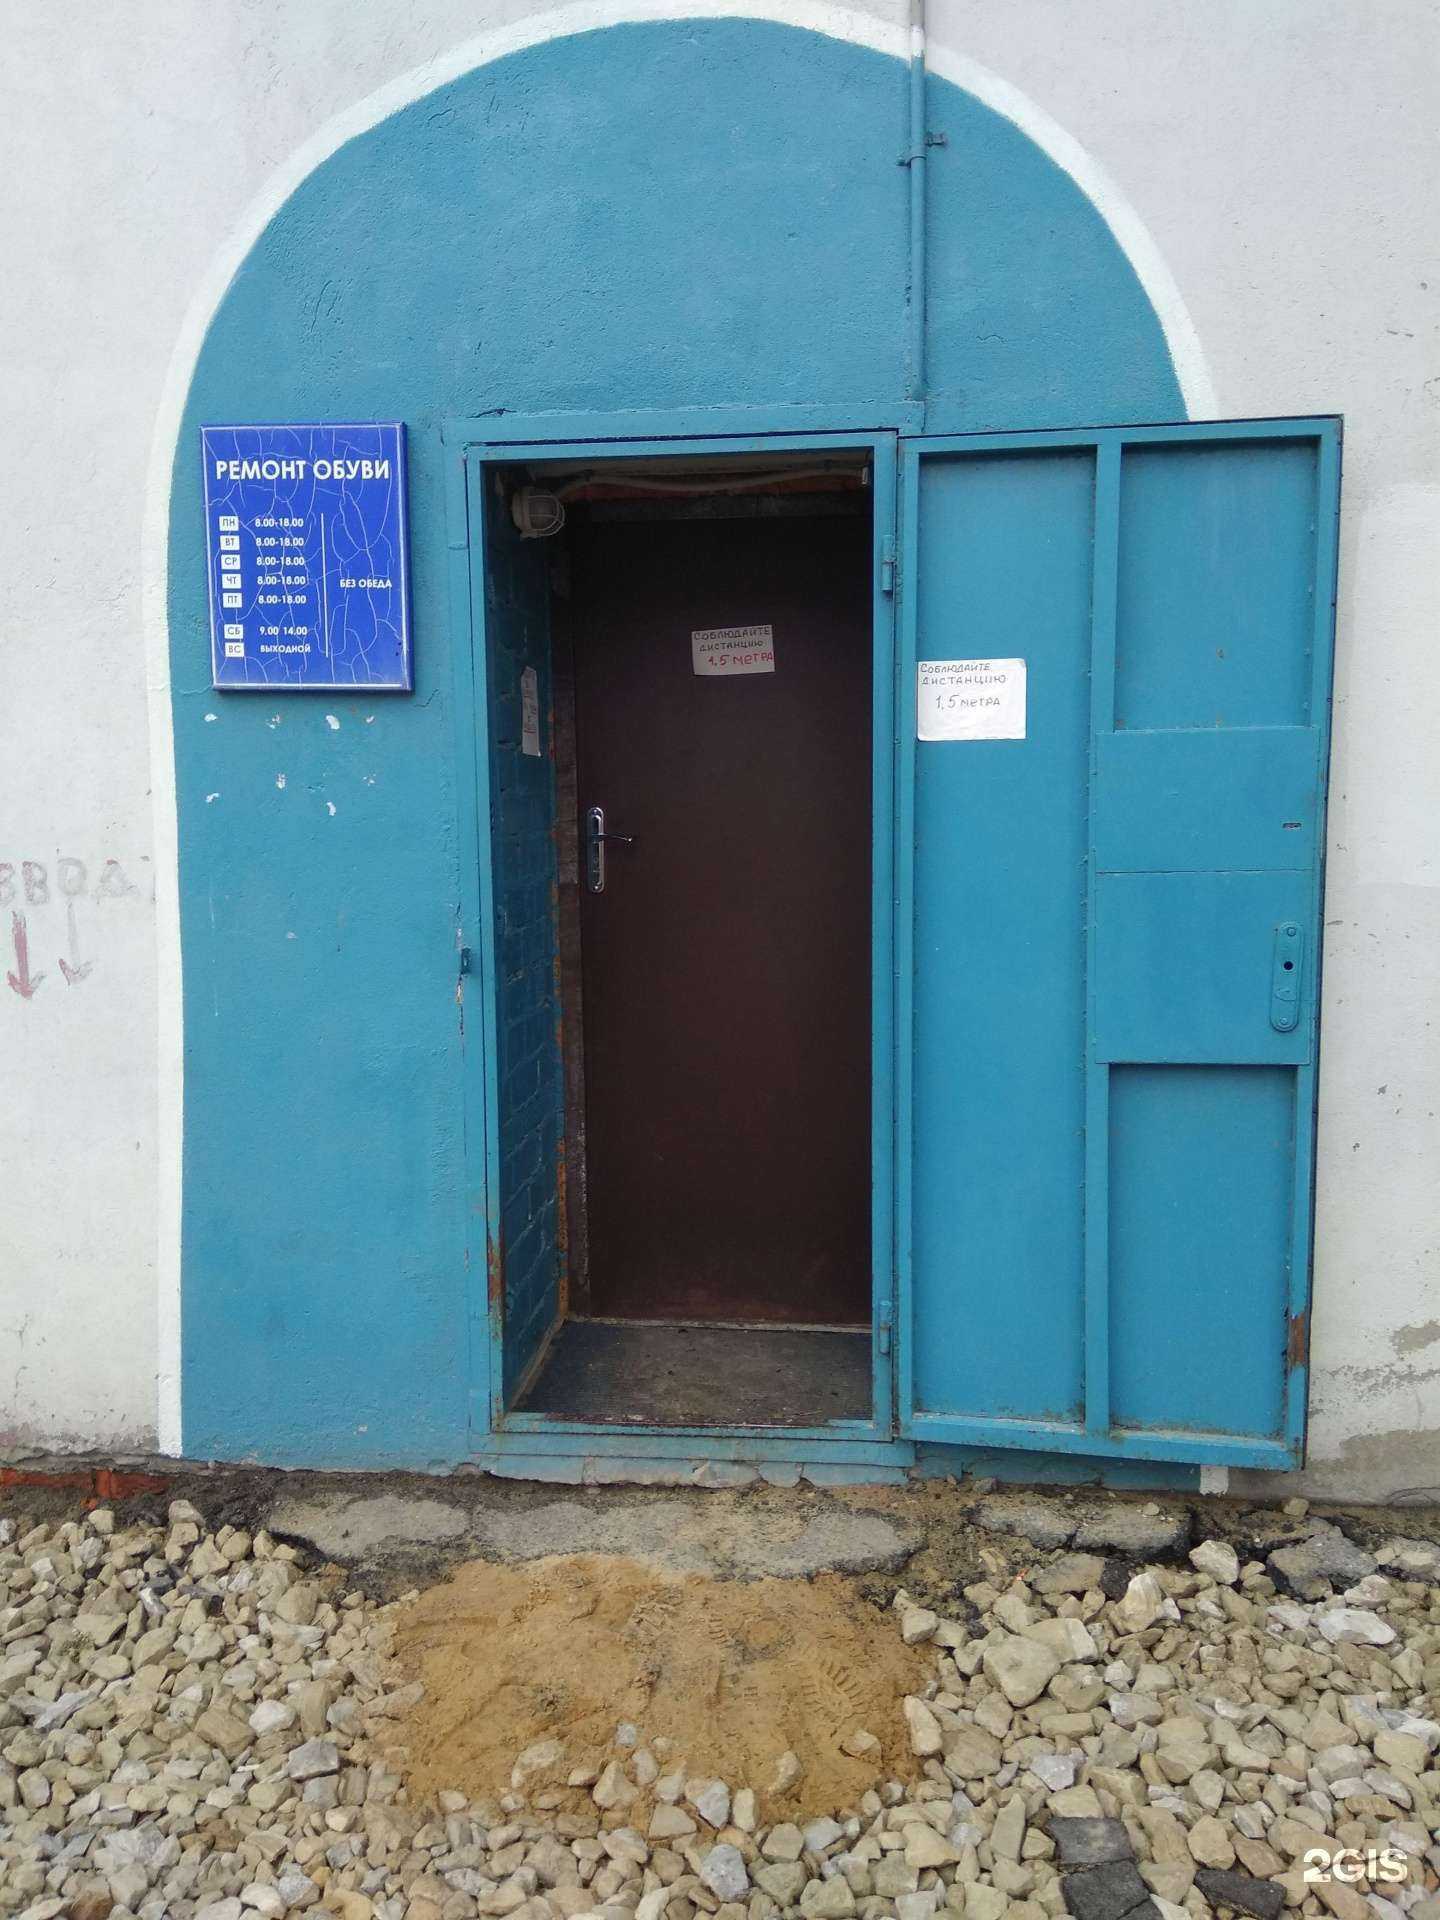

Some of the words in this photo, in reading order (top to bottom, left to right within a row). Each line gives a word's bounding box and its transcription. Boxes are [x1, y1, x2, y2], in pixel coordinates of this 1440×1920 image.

[215, 459, 306, 480] РЕМОНТ
[313, 459, 390, 480] ОБУВИ
[222, 518, 236, 527] ПН
[254, 517, 304, 528] 8.00-18.00
[225, 537, 235, 546] ВТ
[255, 537, 305, 547] 8.00-18.00
[224, 557, 238, 566] СР
[256, 556, 306, 567] 8.00-18.00
[226, 575, 238, 585] ЧТ
[256, 575, 307, 586] 8.00-18.00
[339, 579, 357, 590] БЕЗ
[358, 578, 393, 589] ОБЕДА
[227, 595, 238, 605] ПТ
[257, 594, 307, 605] 8.00-18.00
[227, 626, 241, 636] СБ
[259, 626, 279, 636] 9.00
[283, 626, 308, 636] 14.00
[228, 645, 241, 654] ВС
[260, 643, 312, 654] ВЫХОДНОЙ
[699, 640, 764, 652] ДИСТАНЦИЮ
[921, 674, 1007, 686] ДИСТАНЦИЮ
